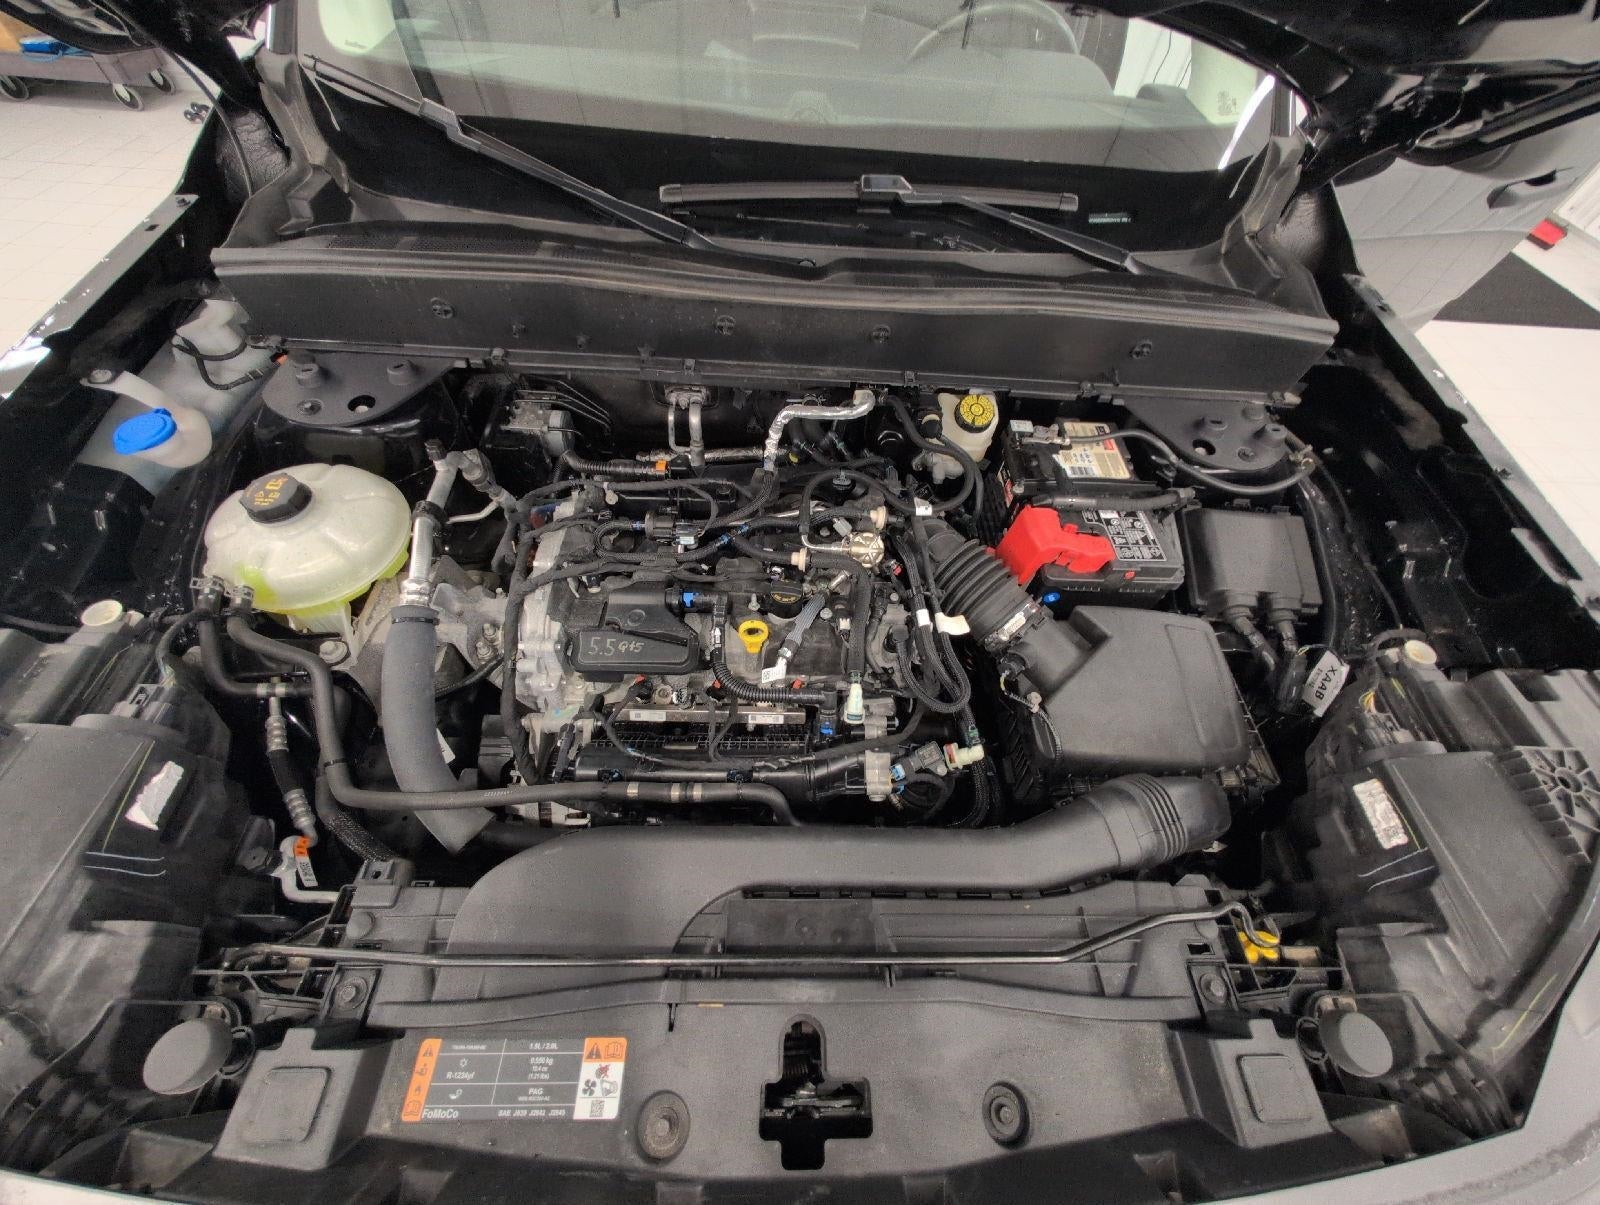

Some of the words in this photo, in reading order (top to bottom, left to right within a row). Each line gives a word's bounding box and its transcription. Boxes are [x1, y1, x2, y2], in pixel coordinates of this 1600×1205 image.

[588, 636, 617, 656] 5.5
[1314, 664, 1338, 701] XAAB
[446, 1071, 475, 1080] R-1234yf
[528, 1087, 544, 1095] PAG
[421, 1108, 459, 1119] FoMoCo
